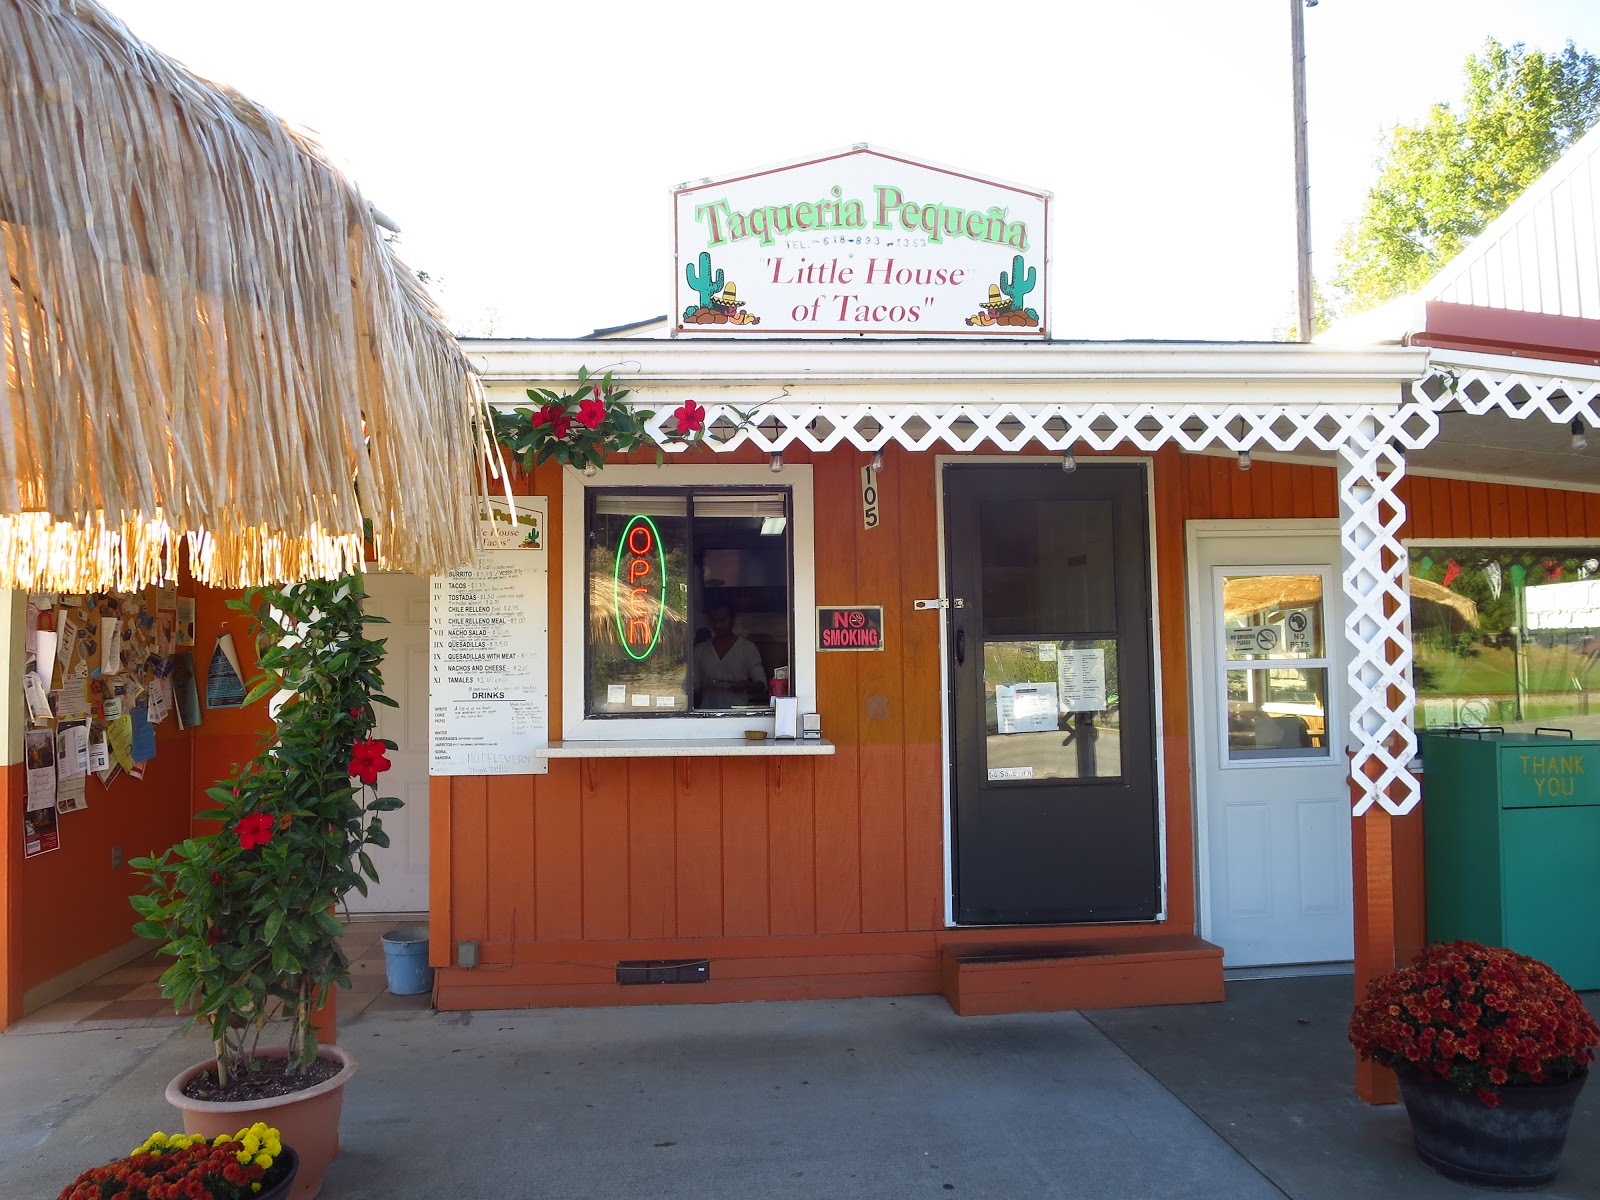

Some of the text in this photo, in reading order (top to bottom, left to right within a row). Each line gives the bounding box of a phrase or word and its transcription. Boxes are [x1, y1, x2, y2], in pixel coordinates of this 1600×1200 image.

[695, 184, 1030, 252] Taqueria Pequeña
[791, 294, 935, 322] of Tacos"
[864, 465, 878, 527] 105
[834, 611, 866, 628] NO
[823, 629, 878, 646] SMOKING
[472, 691, 505, 699] DRINKS
[1520, 755, 1585, 775] THANK
[1534, 777, 1574, 797] YOU
